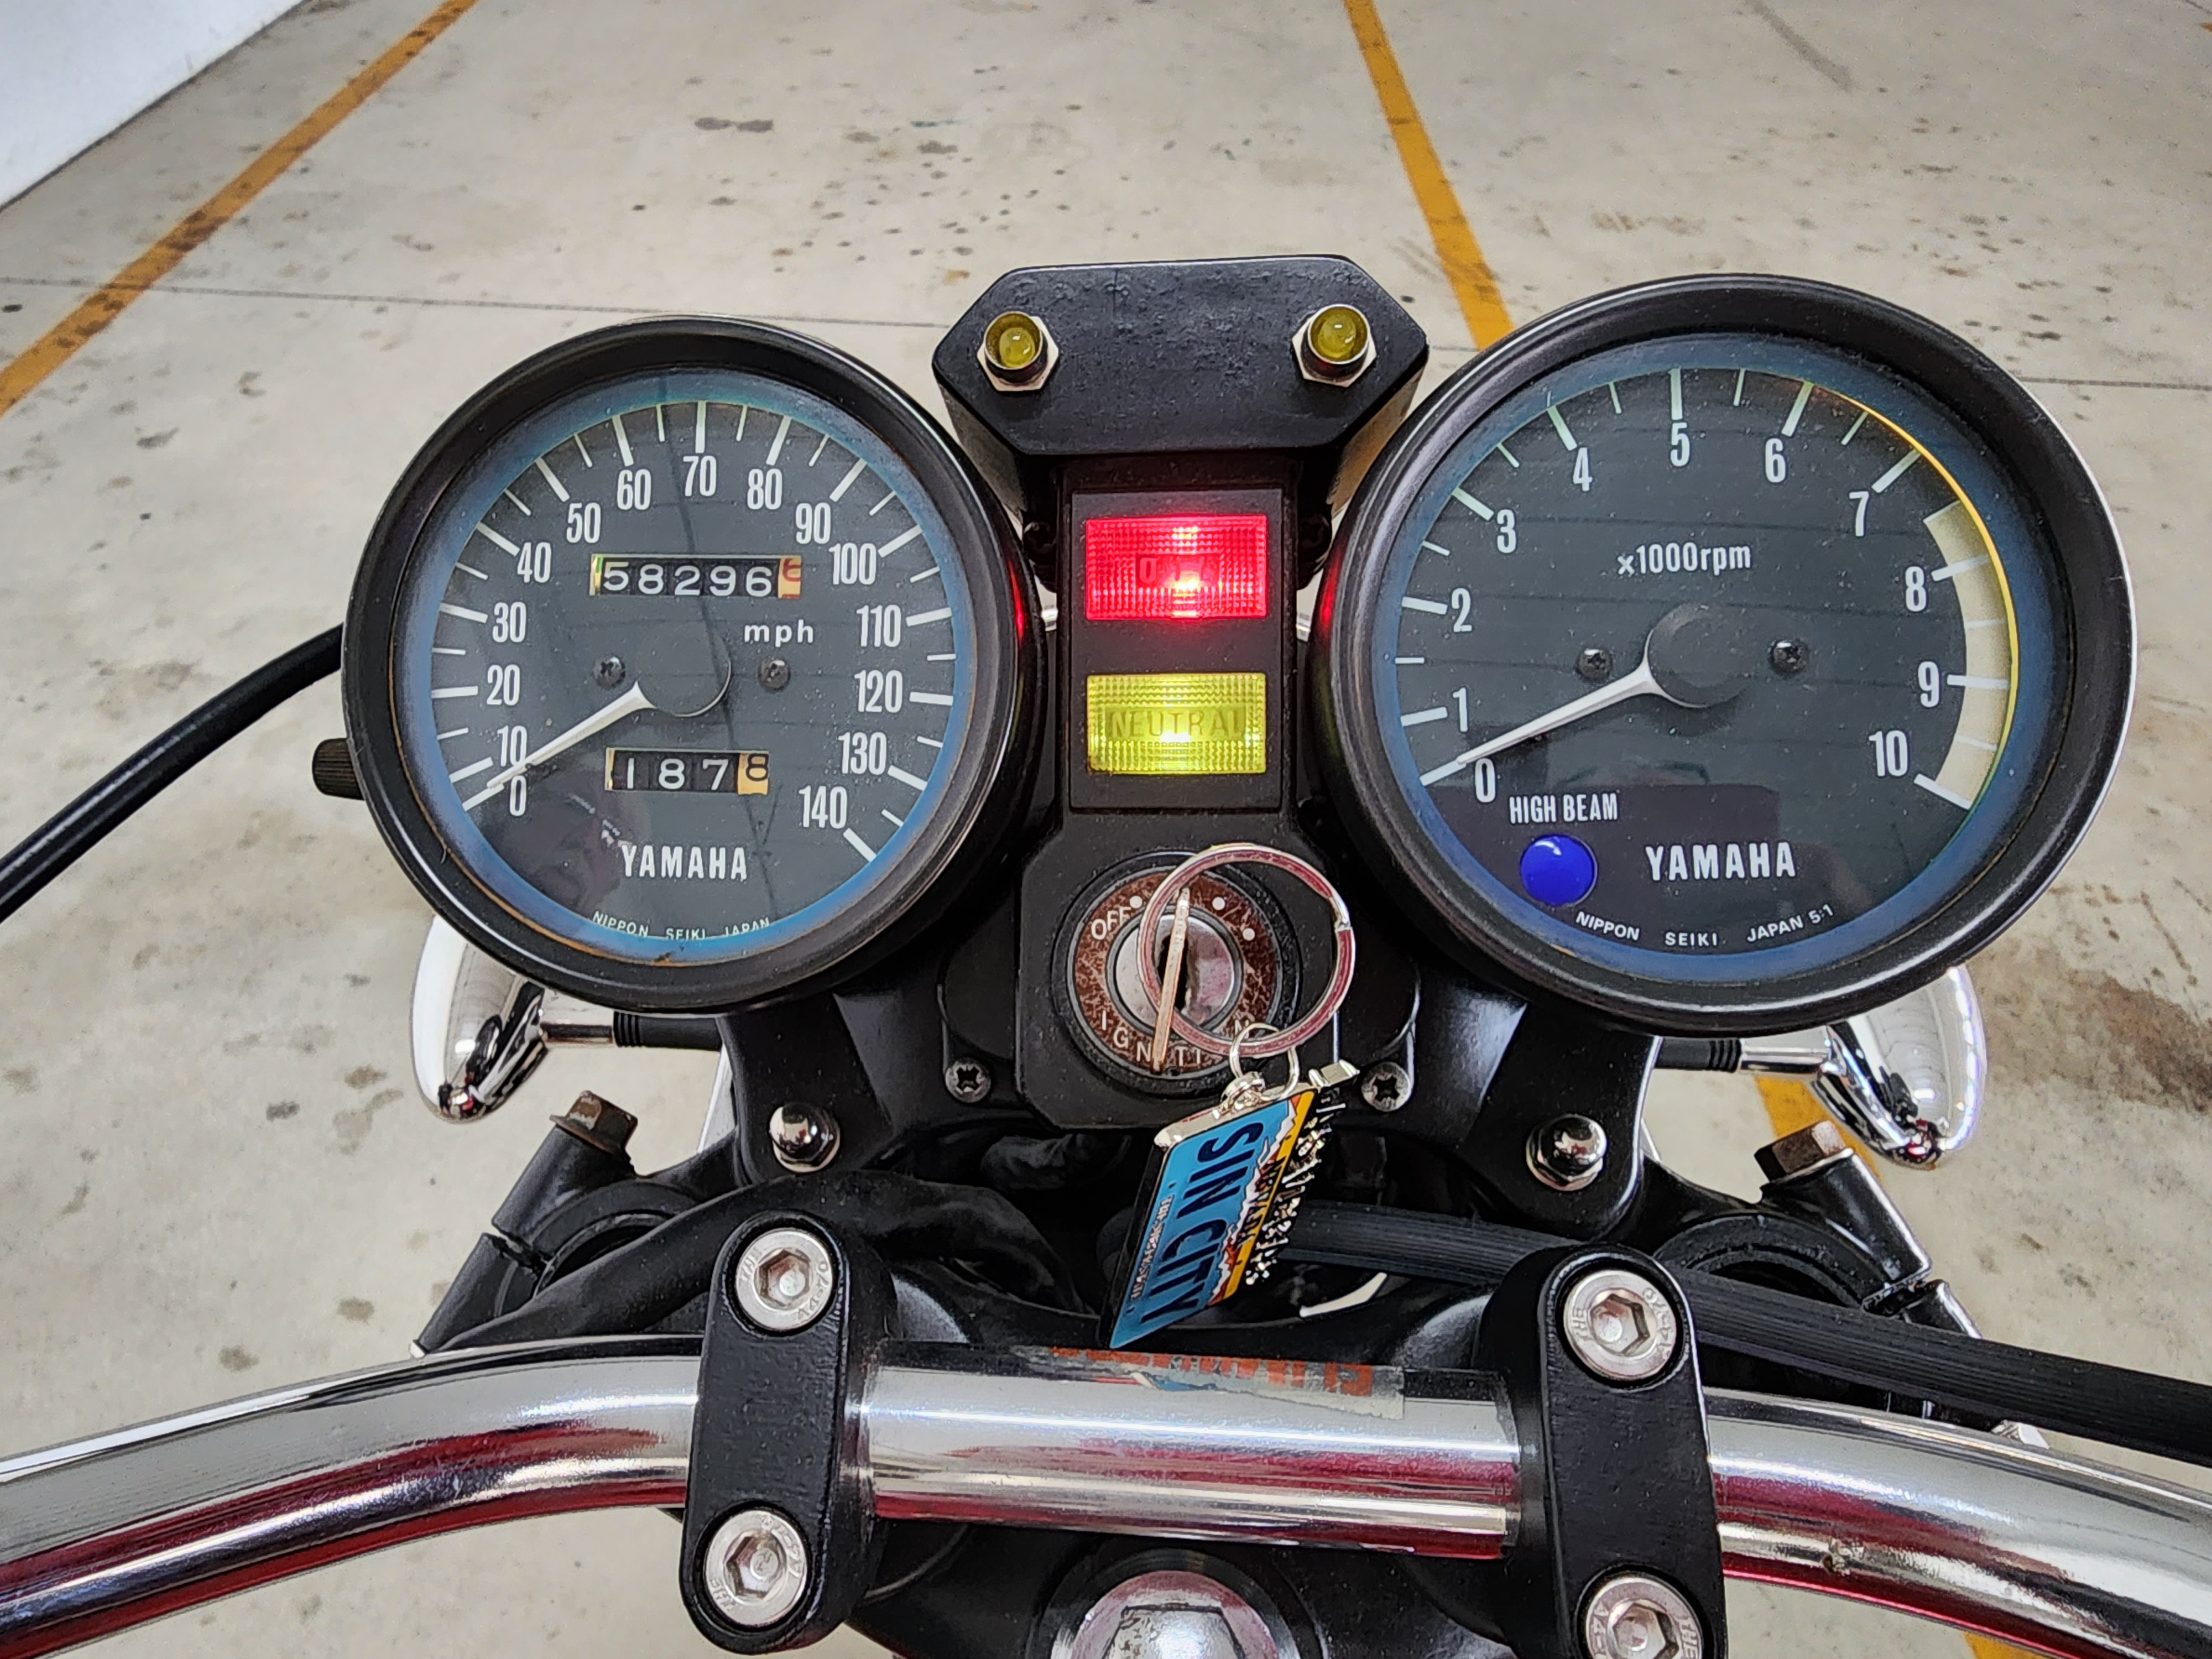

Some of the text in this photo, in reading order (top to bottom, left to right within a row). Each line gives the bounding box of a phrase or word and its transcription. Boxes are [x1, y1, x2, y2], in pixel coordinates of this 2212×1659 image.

[1671, 422, 1690, 467] 5
[1765, 438, 1786, 483] 6
[617, 469, 651, 510] 60
[683, 455, 717, 497] 70
[747, 468, 782, 510] 80
[1573, 447, 1593, 492] 4
[566, 502, 601, 543] 50
[795, 502, 831, 544] 90
[1497, 509, 1516, 554] 3
[1849, 491, 1869, 536] 7
[517, 542, 552, 583] 40
[828, 542, 877, 585] 100
[1618, 542, 1750, 576] x1000rpm
[1452, 588, 1472, 632] 2
[1905, 566, 1926, 612] 8
[492, 602, 526, 643] 30
[744, 619, 813, 648] mph
[856, 604, 901, 648] 110
[486, 664, 520, 706] 20
[854, 670, 903, 713] 120
[1918, 661, 1939, 707] 9
[1110, 710, 1245, 737] NEUTRAL
[1453, 687, 1468, 732] 1
[498, 727, 527, 766] 10
[837, 732, 887, 775] 130
[1869, 730, 1908, 776] 10
[509, 776, 526, 816] 0
[1475, 758, 1496, 802] 0
[799, 785, 848, 829] 140
[1509, 793, 1618, 823] HIGH BEAM
[622, 844, 747, 879] YAMAHA
[1645, 842, 1795, 880] YAMAHA
[593, 911, 770, 940] NIPPON SEIKI JAPAN
[1091, 906, 1132, 940] OFF
[1576, 904, 1833, 945] NIPPON SEIKI JAPAN 5:1
[1101, 1010, 1250, 1067] IGNTIN
[1140, 1123, 1264, 1324] SIN CITY
